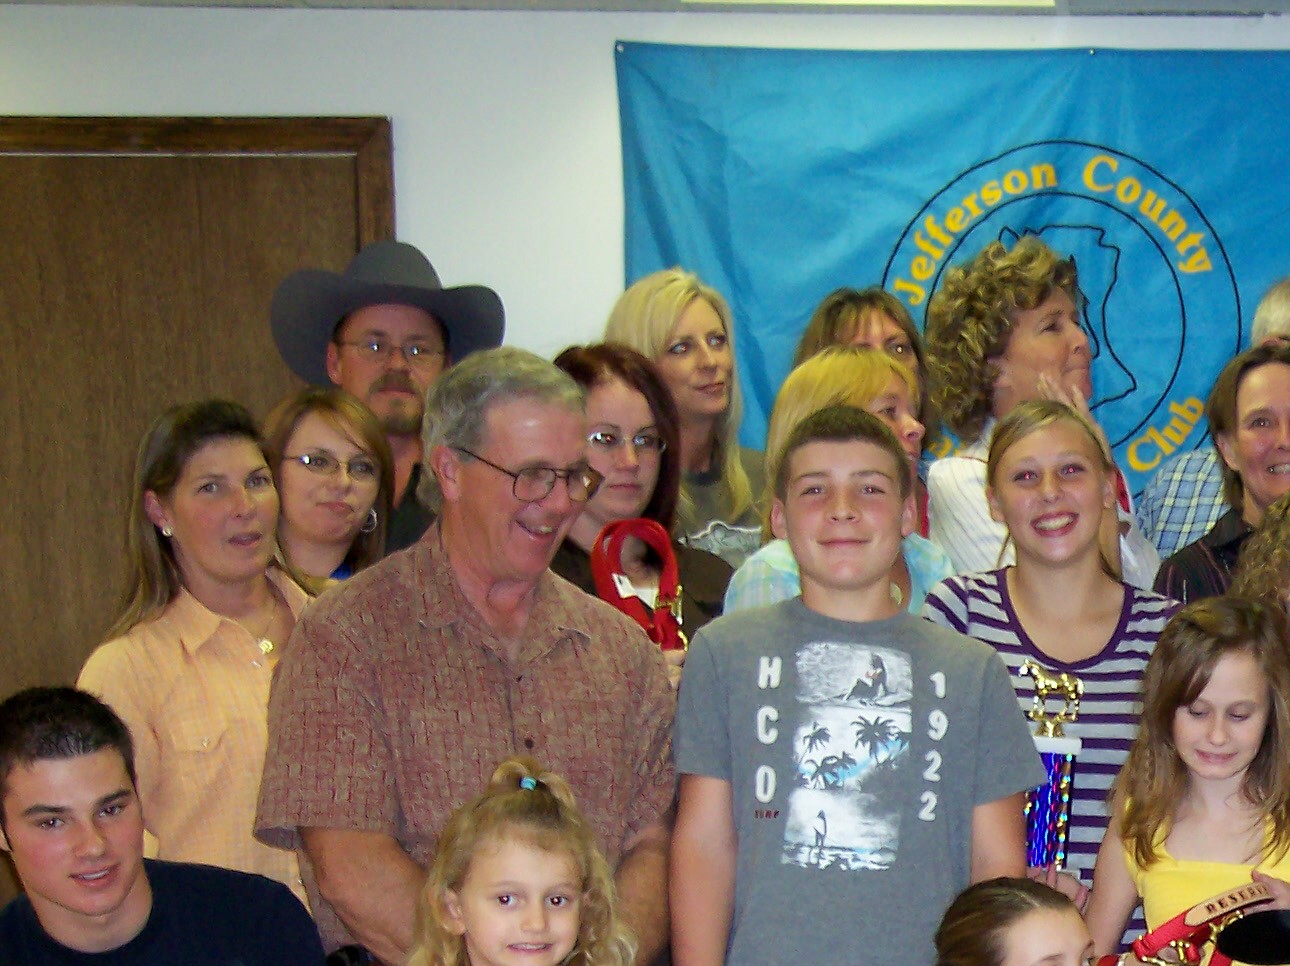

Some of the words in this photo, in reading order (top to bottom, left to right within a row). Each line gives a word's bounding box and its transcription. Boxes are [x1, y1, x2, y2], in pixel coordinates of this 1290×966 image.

[894, 162, 1058, 306] Jefferson
[1082, 154, 1213, 275] County
[1126, 395, 1206, 473] Club
[918, 671, 949, 822] 1922
